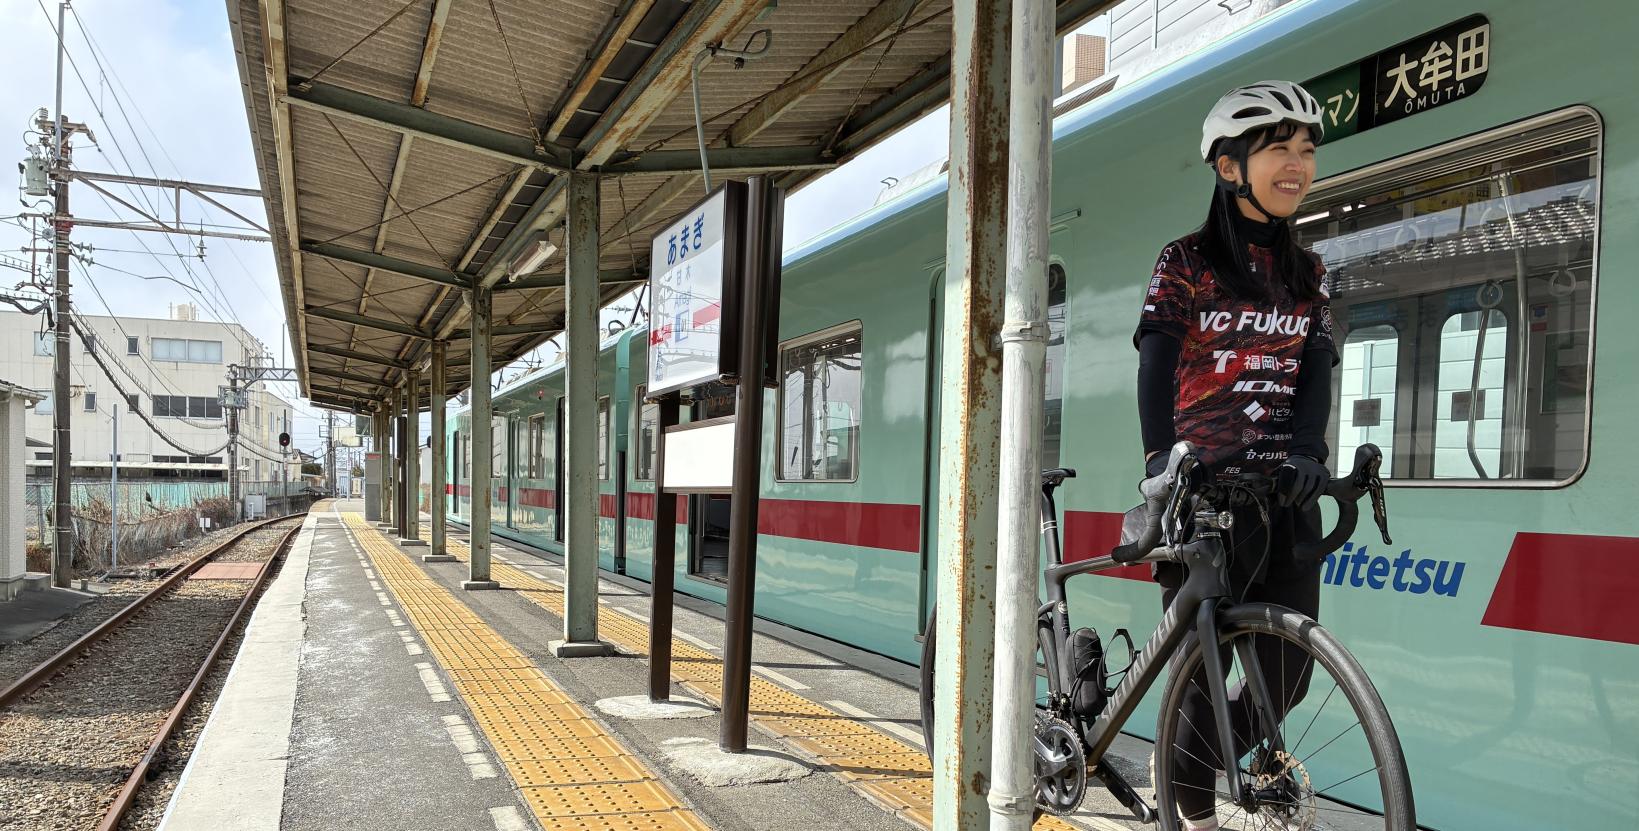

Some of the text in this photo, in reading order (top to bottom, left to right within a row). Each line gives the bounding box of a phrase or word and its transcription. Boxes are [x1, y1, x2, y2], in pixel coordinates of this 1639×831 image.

[1384, 23, 1490, 108] 大牟田
[1404, 82, 1466, 114] ŌMUTA
[668, 212, 705, 266] あまぎ
[1199, 311, 1233, 332] VC
[1243, 354, 1301, 373] 福岡トラ
